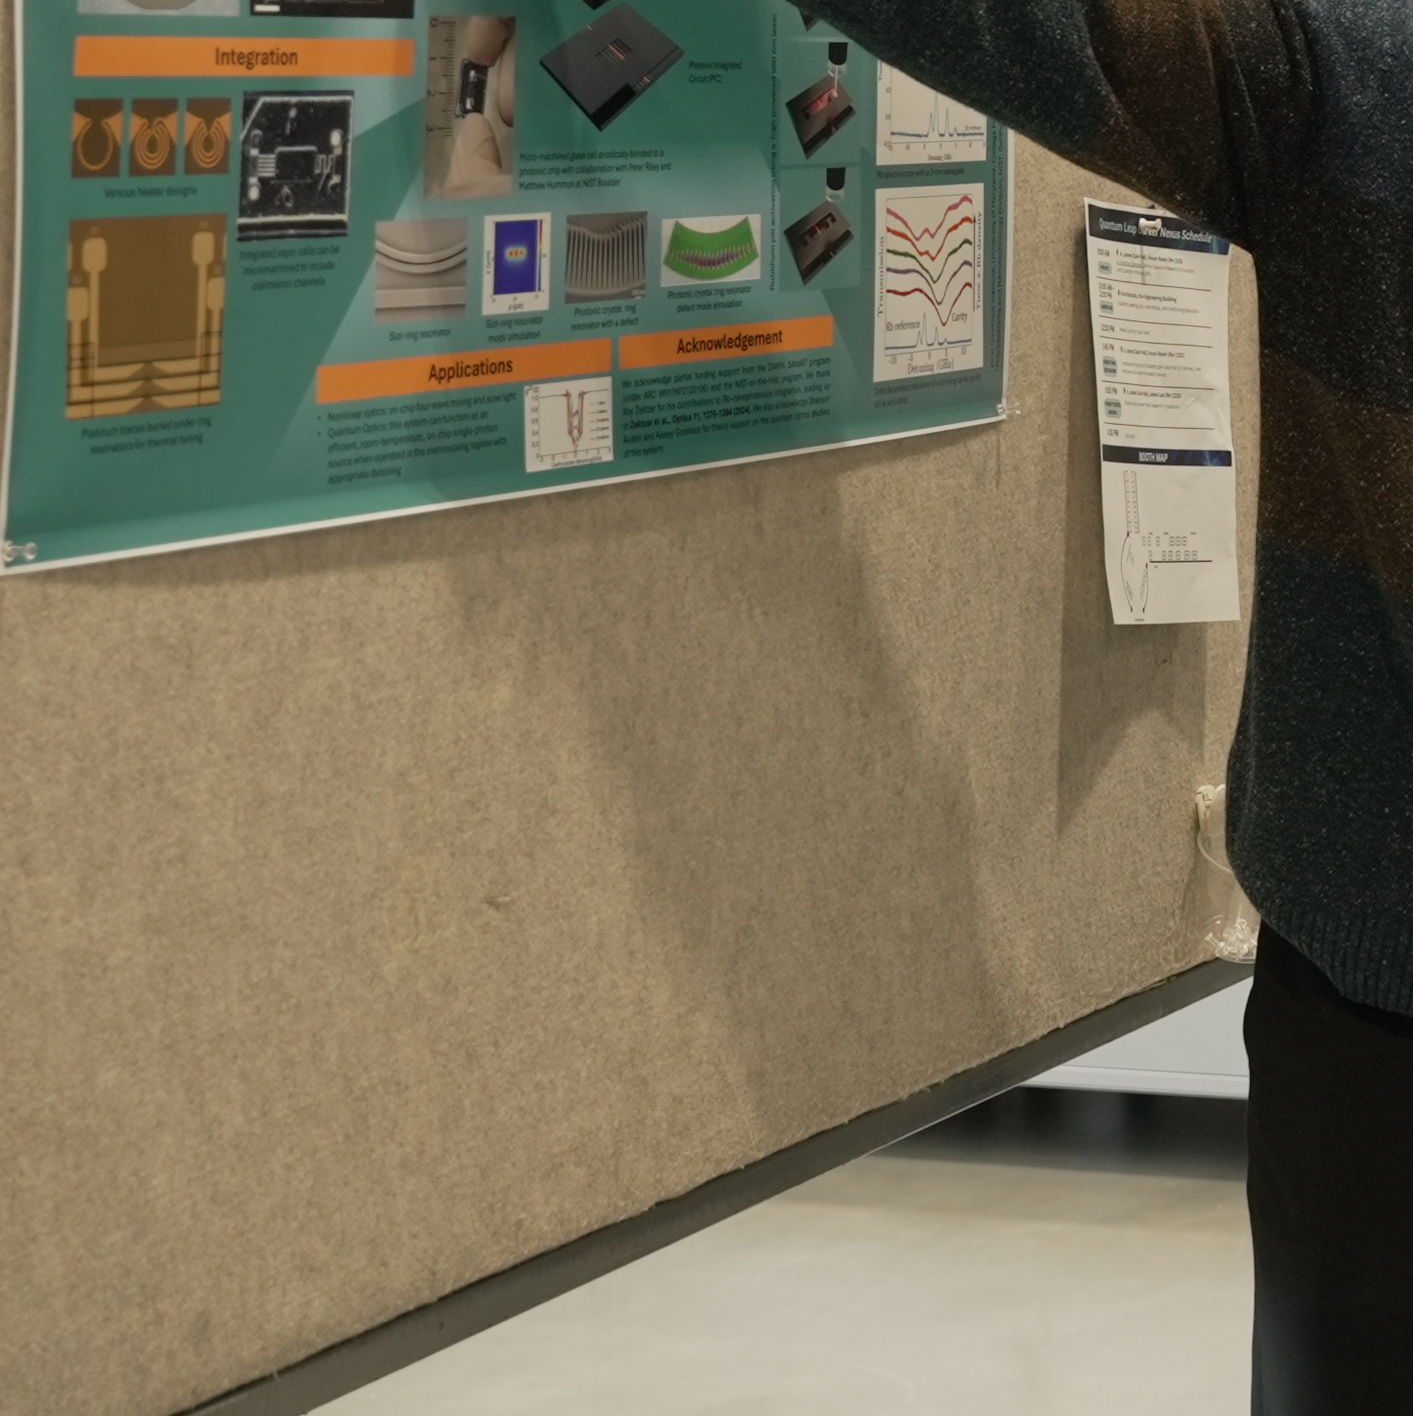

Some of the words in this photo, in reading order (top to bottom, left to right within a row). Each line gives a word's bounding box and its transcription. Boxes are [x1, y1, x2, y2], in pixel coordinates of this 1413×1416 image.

[215, 47, 298, 71] Integration
[1160, 227, 1180, 240] Nexus
[1182, 229, 1212, 242] Schedule
[677, 330, 783, 354] Acknowledgement
[428, 358, 513, 384] Applications
[1155, 453, 1168, 462] MAP
